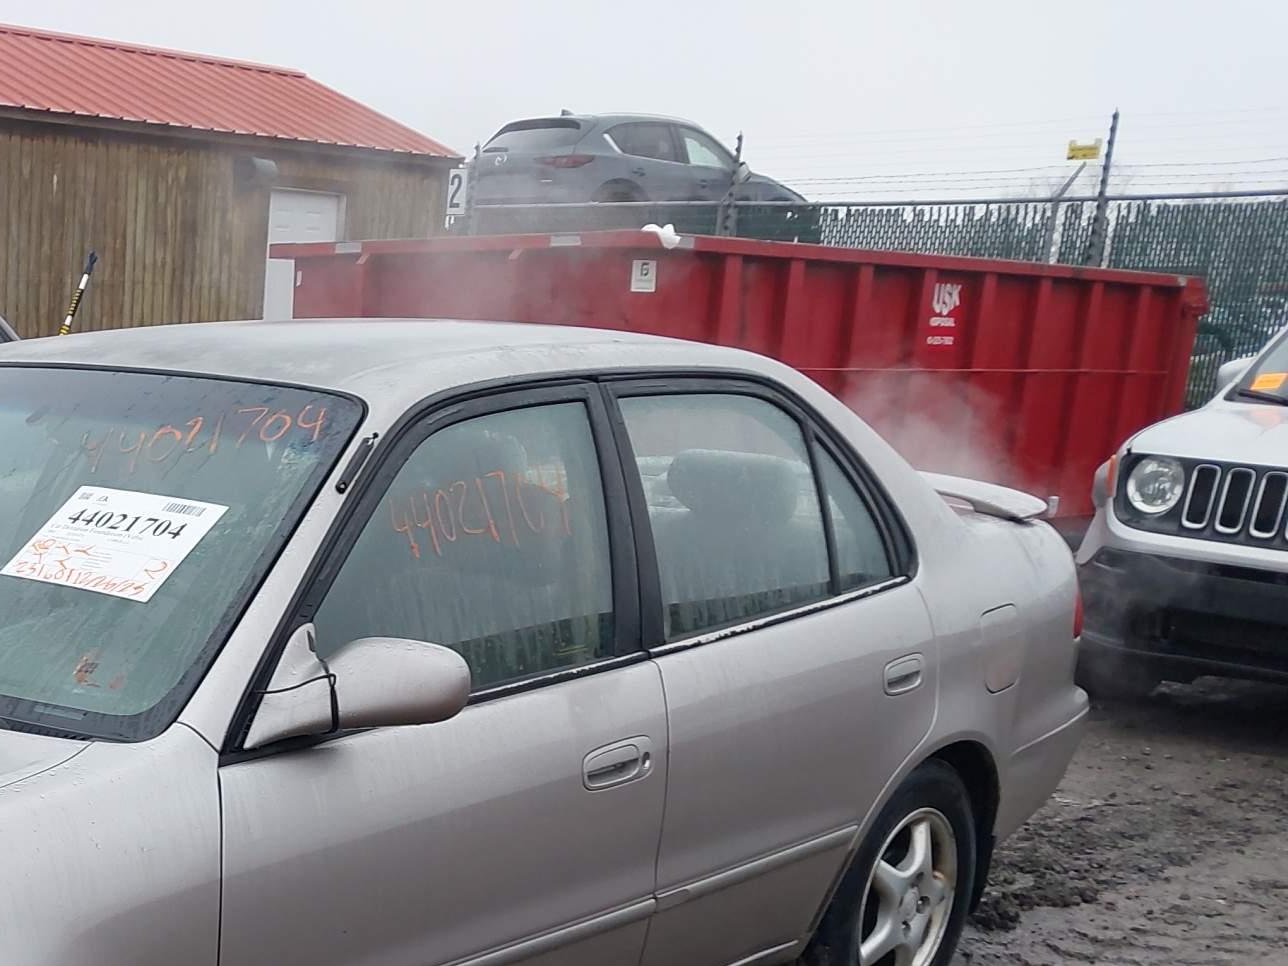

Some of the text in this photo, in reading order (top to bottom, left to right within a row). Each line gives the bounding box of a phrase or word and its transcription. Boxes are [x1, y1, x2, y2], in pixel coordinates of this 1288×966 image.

[449, 174, 462, 208] 2
[80, 404, 327, 473] 44021704
[68, 508, 188, 540] 44021704
